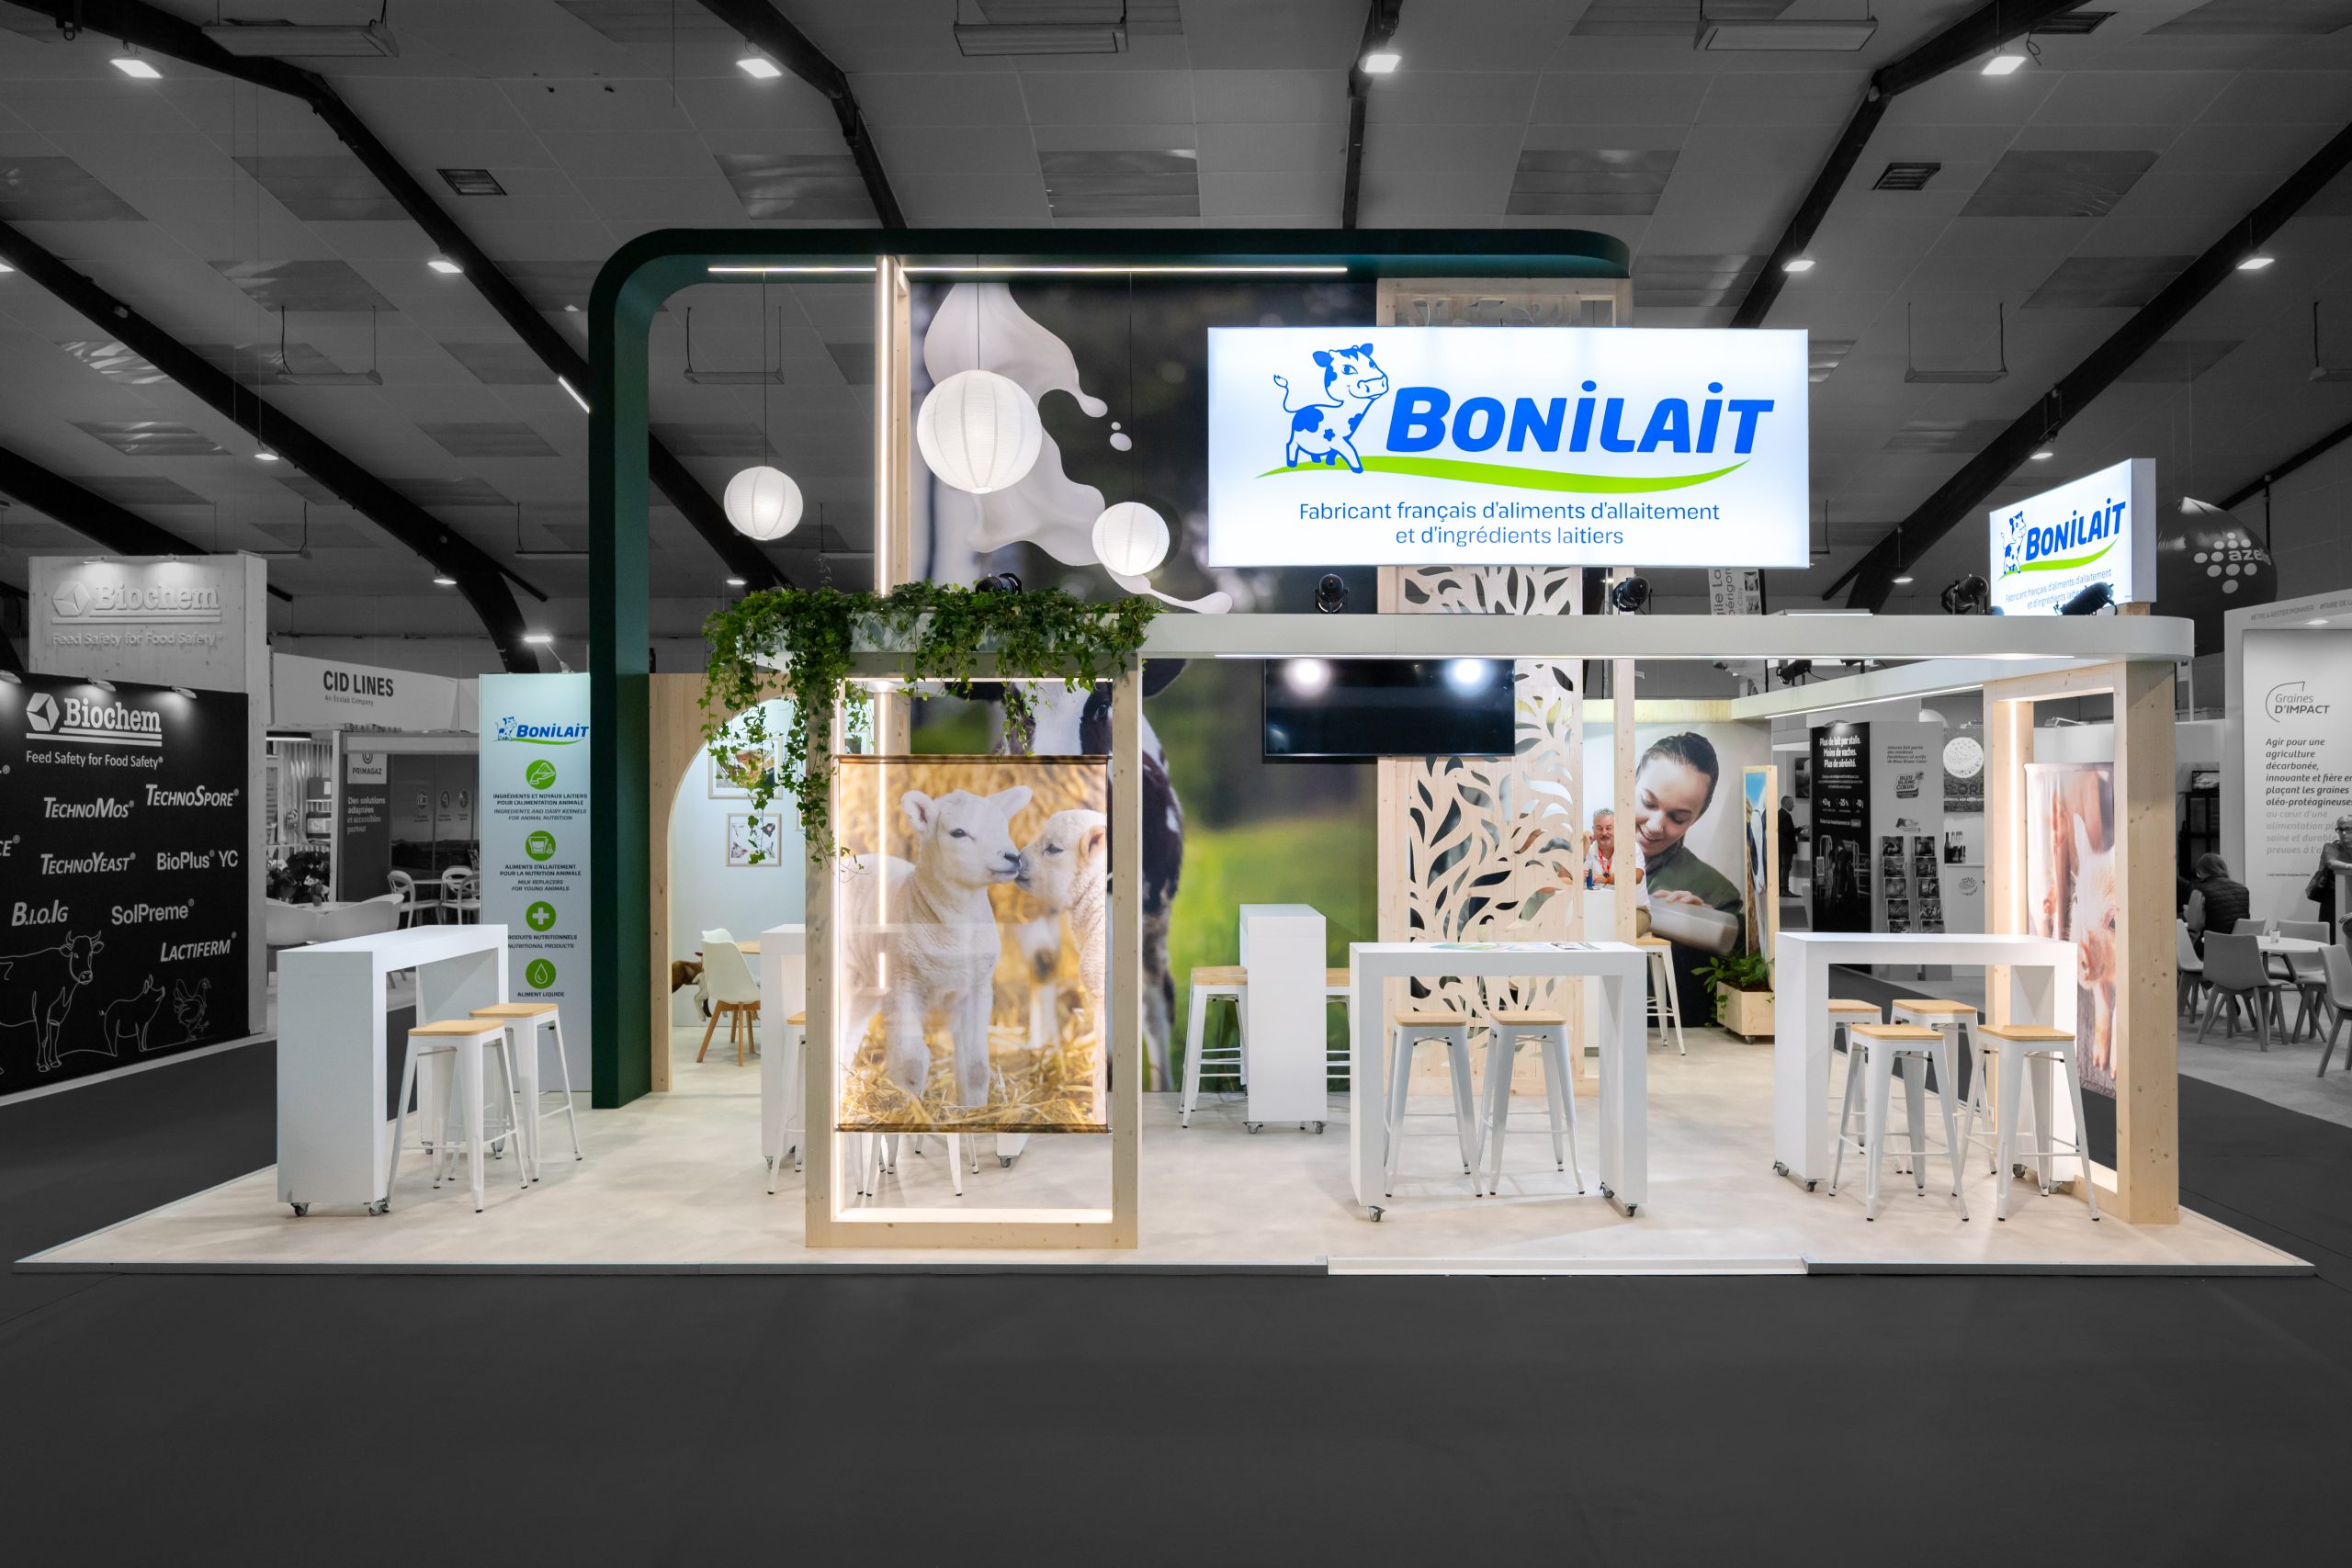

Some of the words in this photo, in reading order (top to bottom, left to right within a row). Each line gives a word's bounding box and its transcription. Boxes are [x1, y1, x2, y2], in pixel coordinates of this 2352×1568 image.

[1300, 502, 1391, 520] Fabricant
[1396, 502, 1476, 524] français
[1483, 502, 1584, 520] d'aliments
[1591, 502, 1720, 520] d'allaitement
[1396, 528, 1416, 544] et
[1421, 525, 1552, 547] d'ingrédients
[1557, 525, 1623, 545] laitiers
[2075, 569, 2111, 585] d'allaitement
[95, 582, 220, 610] Biochem
[52, 633, 82, 645] Feed
[85, 633, 120, 647] Safety
[125, 632, 142, 645] for
[145, 632, 175, 645] Food
[323, 671, 349, 692] CID
[354, 674, 394, 697] LINES
[2275, 694, 2313, 704] Graines
[64, 696, 162, 732] Biochem
[2274, 705, 2330, 714] D'IMPACT
[2266, 738, 2284, 748] Agir
[2286, 739, 2307, 748] pour
[26, 750, 51, 763] Feed
[54, 751, 86, 767] Safety
[88, 752, 102, 765] for
[105, 753, 128, 767] Food
[2266, 750, 2315, 760] agriculture
[1824, 759, 1833, 768] Plus
[1833, 759, 1838, 767] de
[2266, 761, 2319, 772] décarbonée,
[2323, 773, 2343, 784] fière
[2266, 786, 2300, 795] plaçant
[2316, 786, 2349, 796] graines
[348, 796, 359, 805] Des
[360, 795, 386, 805] solutions
[2267, 821, 2323, 829] alimentation
[218, 850, 239, 867] YC
